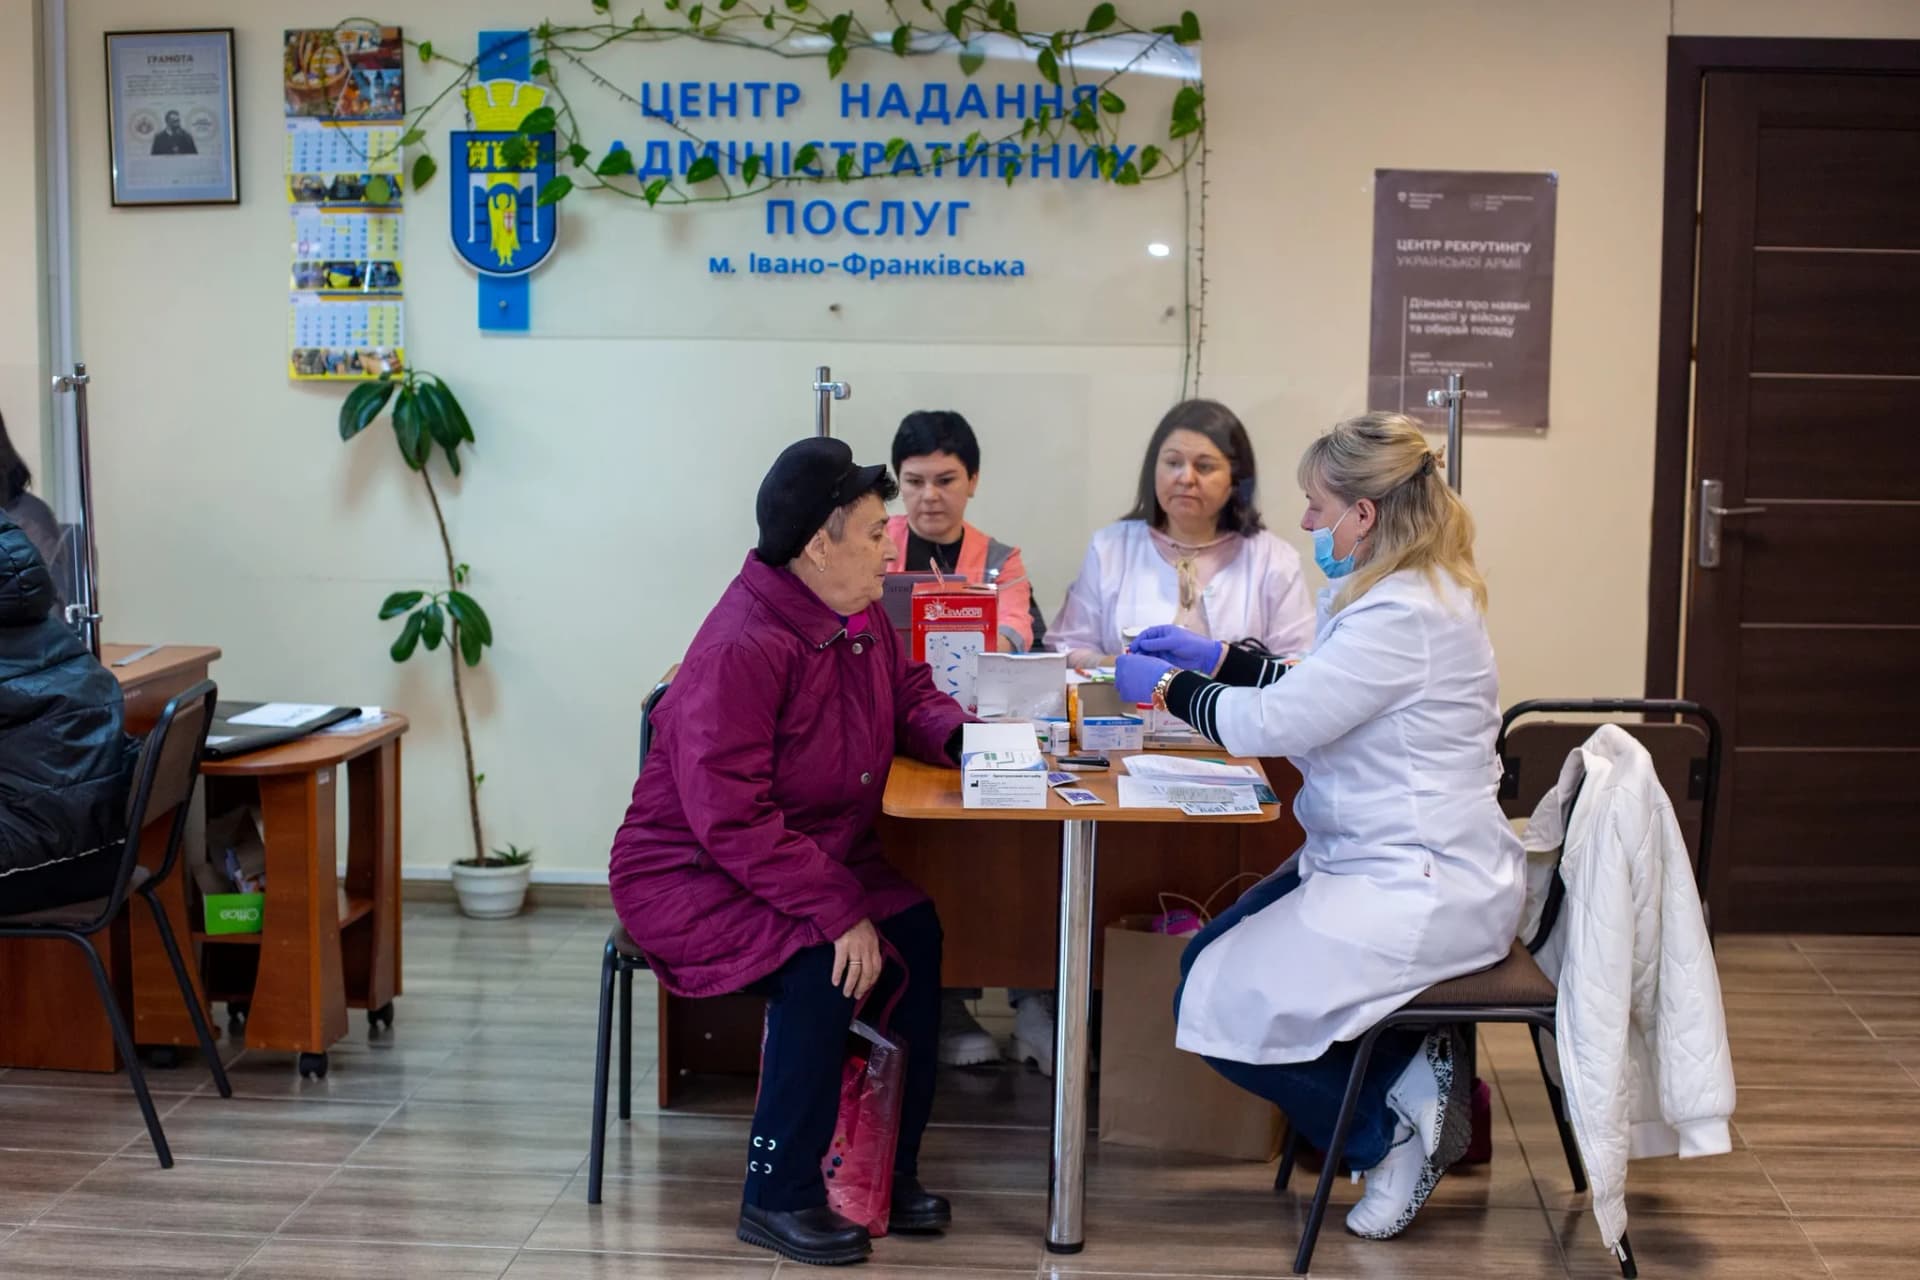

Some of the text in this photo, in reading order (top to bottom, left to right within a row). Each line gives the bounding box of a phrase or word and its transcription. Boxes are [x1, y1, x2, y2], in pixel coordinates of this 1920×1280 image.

[640, 81, 1099, 125] ЦЕНТР НАДАННЯ
[765, 199, 971, 237] ПОСЛУГ
[1396, 239, 1531, 253] ЦЕНТР РЕКРУТИНГУ
[708, 252, 1025, 280] м. Івано-Франківська
[1466, 301, 1488, 312] про
